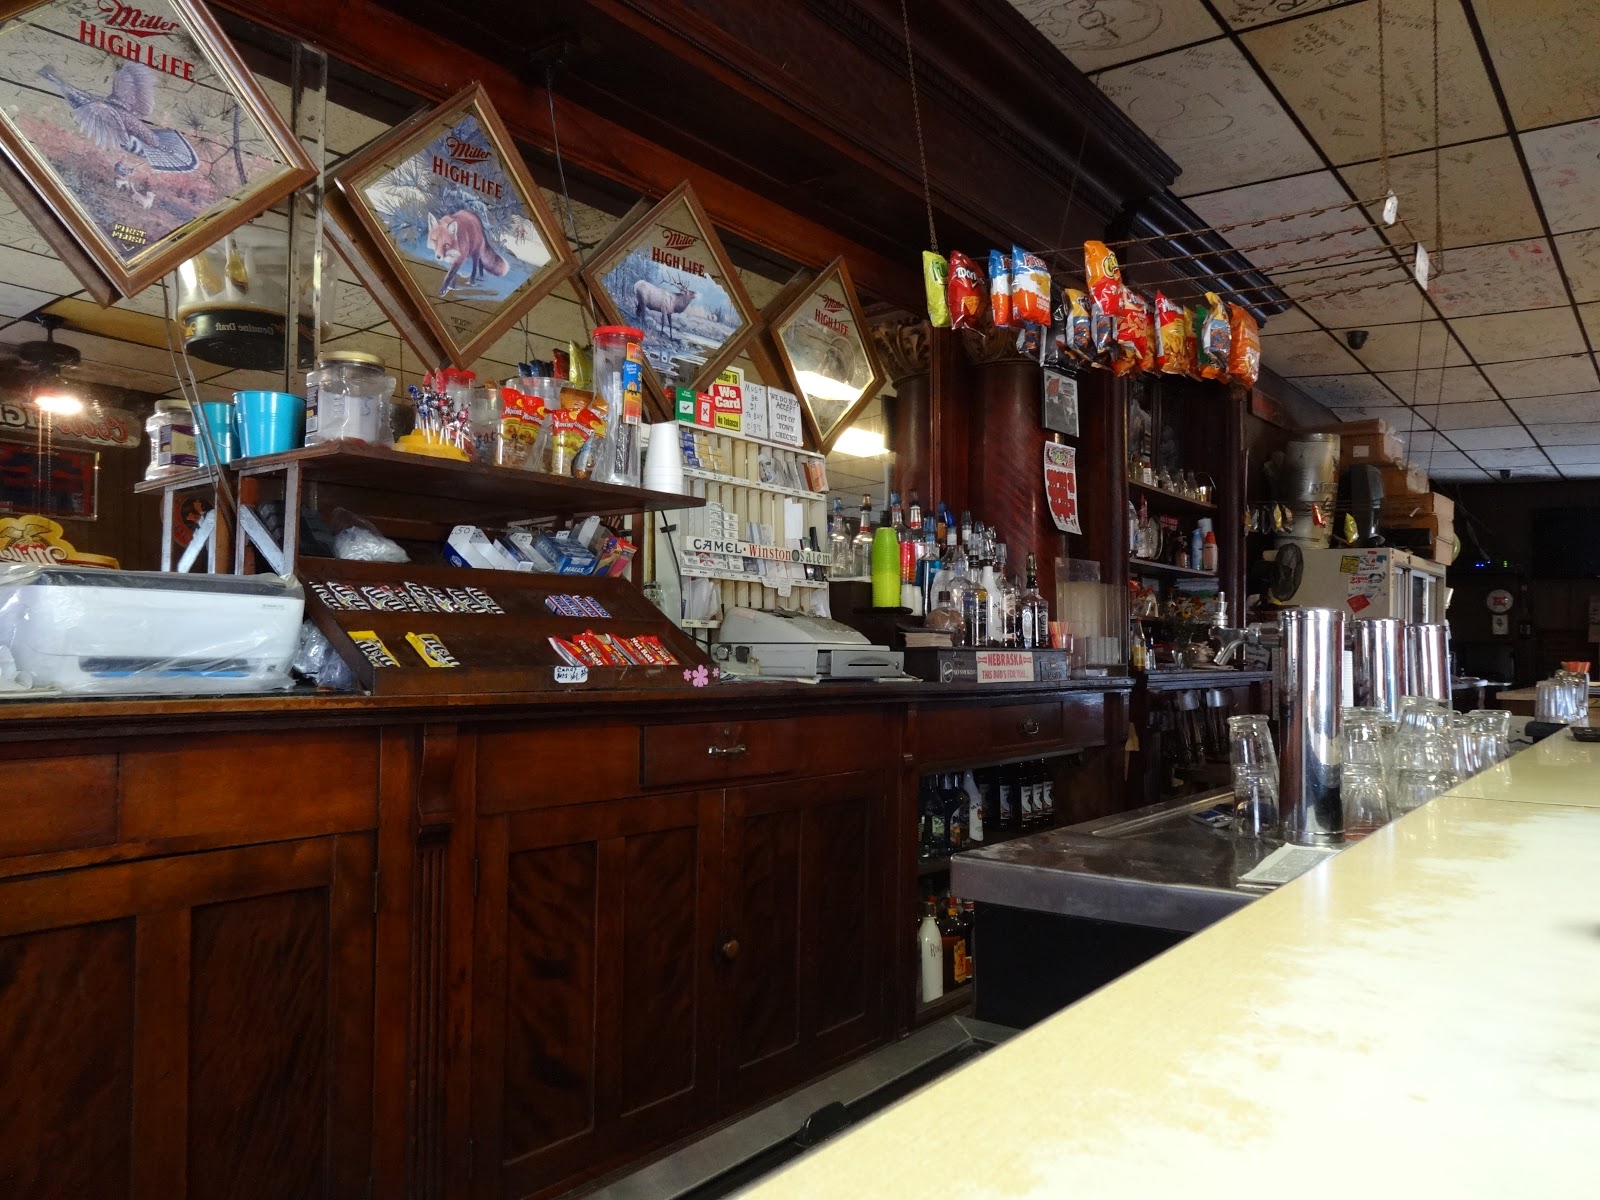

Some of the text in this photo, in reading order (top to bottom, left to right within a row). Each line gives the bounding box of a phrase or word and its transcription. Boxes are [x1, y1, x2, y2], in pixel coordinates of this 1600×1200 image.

[96, 0, 181, 33] Miller
[78, 20, 195, 82] HIGH LIFE
[446, 136, 493, 159] Miller
[432, 155, 503, 200] HIGH LIFE
[113, 223, 147, 238] FIRST
[661, 229, 697, 248] Miller
[651, 246, 705, 279] HIGH LIFE
[814, 309, 849, 337] HIGH LIFE
[714, 396, 741, 409] Card
[717, 385, 737, 399] We
[779, 395, 787, 403] DO
[693, 538, 743, 554] CAMEL
[748, 543, 791, 561] Winston
[578, 639, 604, 666] Nut Roll
[630, 637, 655, 664] Nut Roll
[987, 653, 1024, 667] NEBRASKA
[981, 670, 993, 680] THIS
[1007, 669, 1017, 679] FOR
